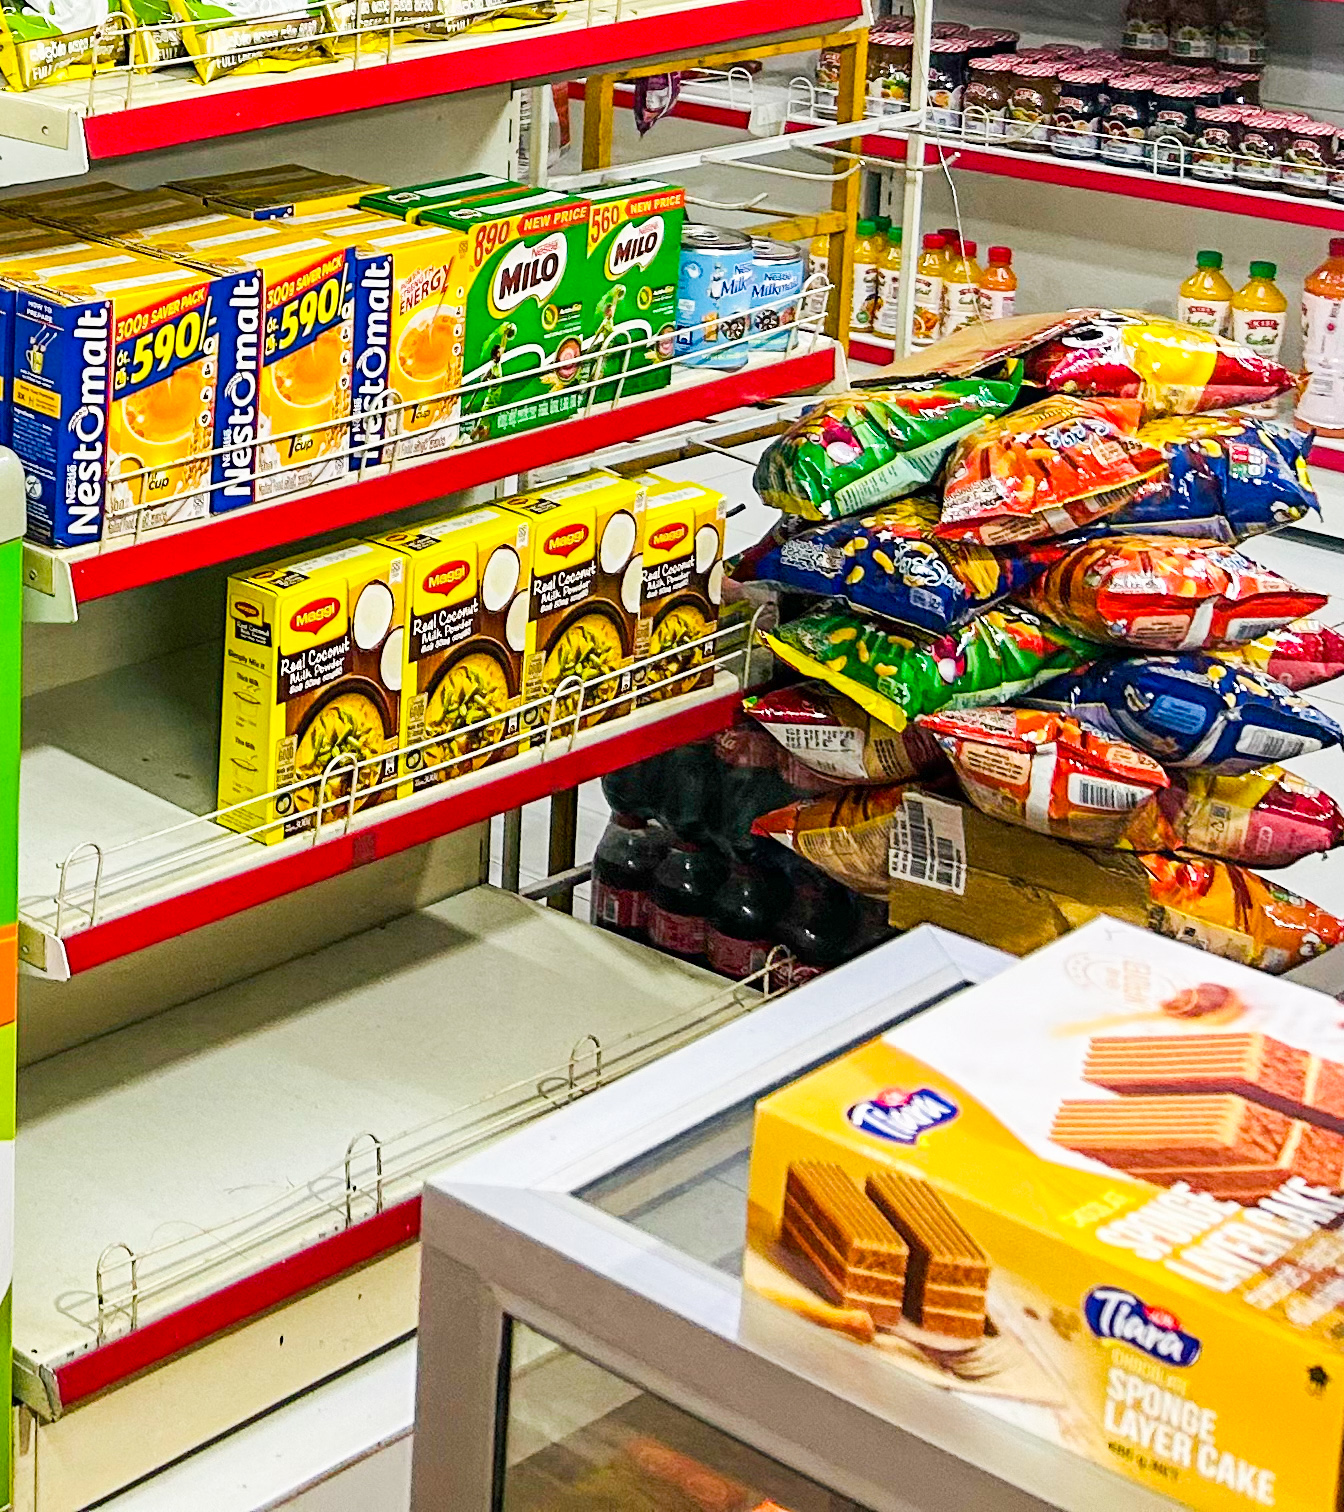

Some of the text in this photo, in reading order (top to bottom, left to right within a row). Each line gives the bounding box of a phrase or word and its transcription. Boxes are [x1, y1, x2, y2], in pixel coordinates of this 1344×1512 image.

[524, 207, 588, 231] NEW PRICE
[632, 194, 681, 214] NEW PRICE
[474, 221, 510, 268] 890
[591, 207, 620, 244] 560
[615, 231, 657, 266] MILO
[499, 254, 558, 300] MILO
[117, 288, 207, 342] 300g SAVER PACK
[280, 264, 352, 346] 590/-
[132, 296, 216, 384] 590/-
[548, 534, 584, 549] Maggi
[533, 561, 596, 594] Real Coconut
[540, 579, 591, 604] Milk Powder
[296, 602, 335, 627] Maggi
[281, 637, 350, 676] Real Coconut
[290, 657, 345, 685] Milk Powder
[854, 1096, 956, 1141] Tiara
[1092, 1291, 1186, 1366] Tiara
[1107, 1368, 1218, 1438] SPONGE
[1103, 1413, 1194, 1478] LAYER
[1196, 1442, 1276, 1507] CAKE
